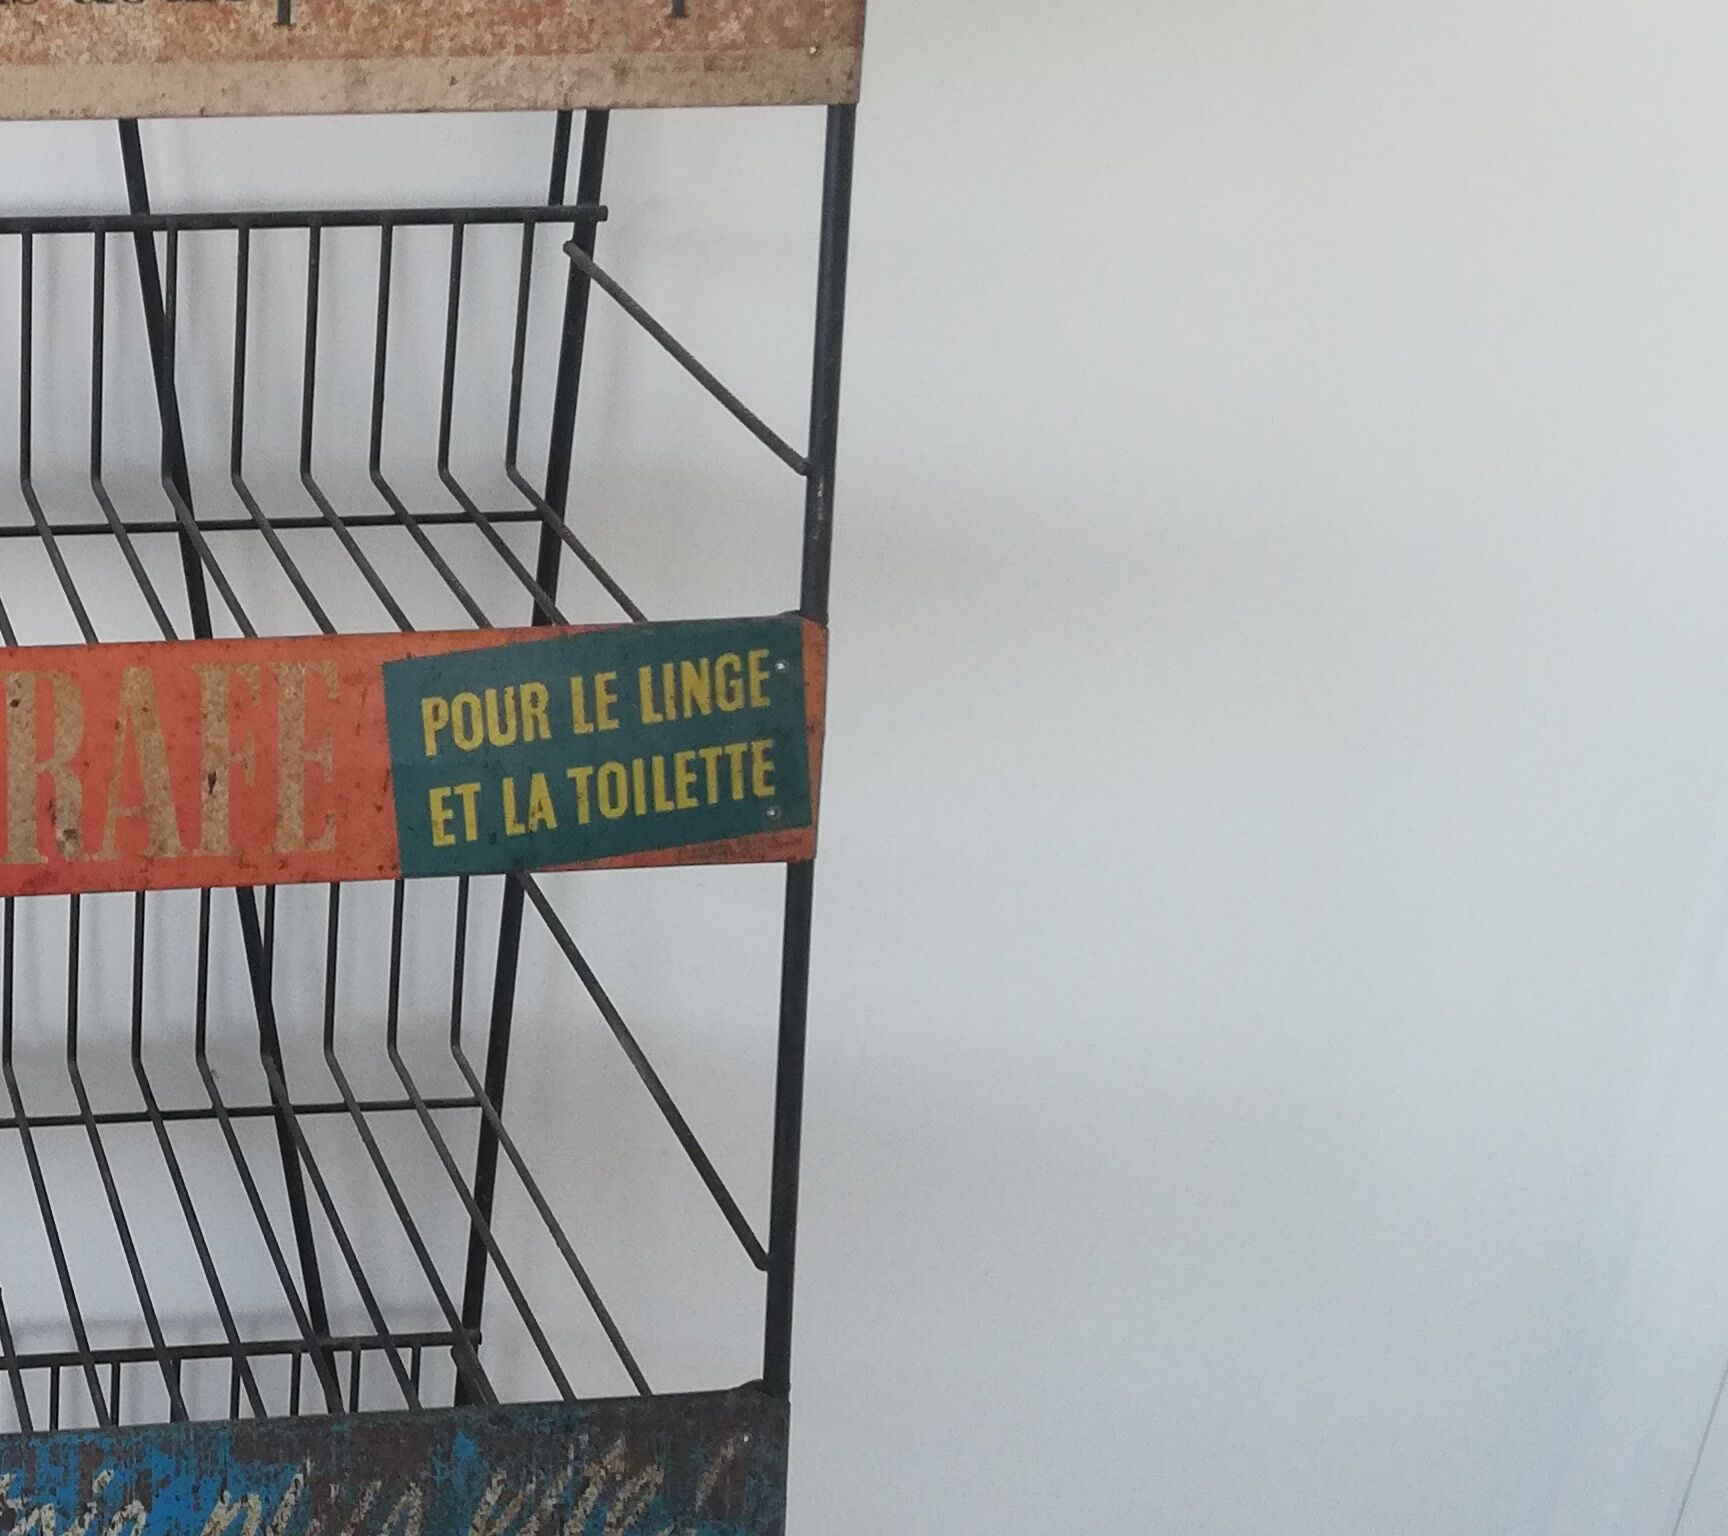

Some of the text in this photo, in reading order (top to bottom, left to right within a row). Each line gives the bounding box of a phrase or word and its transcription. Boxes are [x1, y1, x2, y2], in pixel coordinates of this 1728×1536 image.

[420, 648, 771, 758] POUR LE LINGE
[428, 738, 777, 848] ET LA TOILETTE
